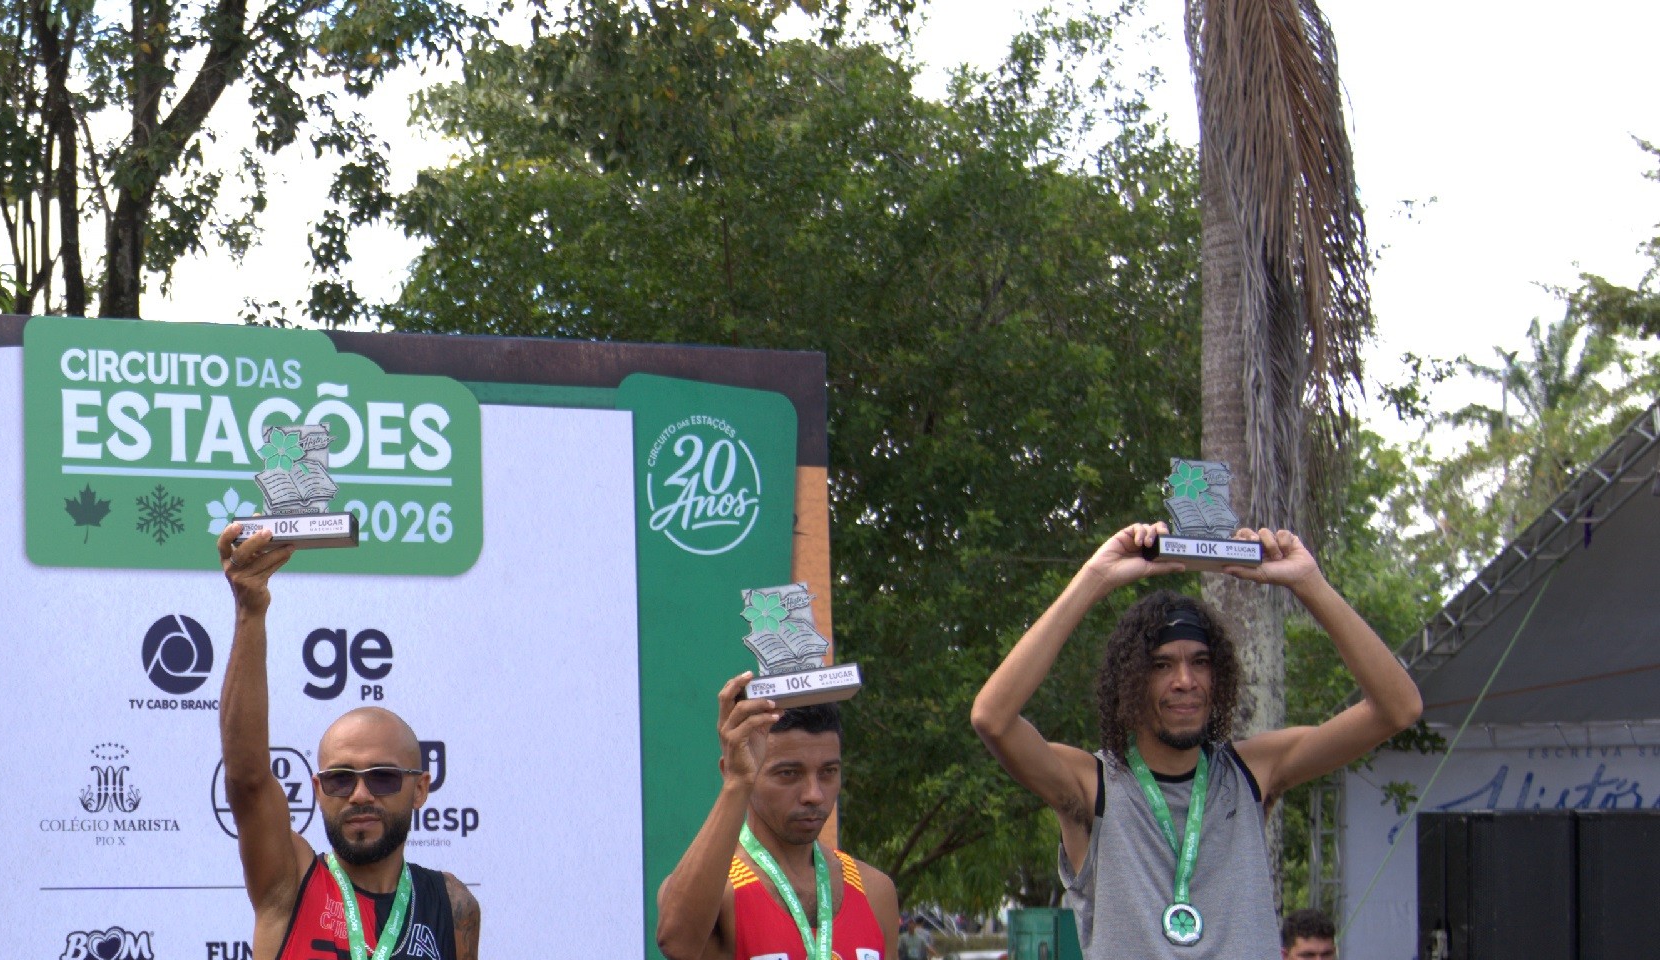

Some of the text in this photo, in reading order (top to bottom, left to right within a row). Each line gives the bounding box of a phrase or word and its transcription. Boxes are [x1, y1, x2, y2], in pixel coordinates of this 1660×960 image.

[61, 348, 302, 389] CIRCUITO DAS
[648, 425, 677, 467] CIRCUITO
[690, 415, 736, 438] ESTAÇÕES
[664, 435, 737, 495] 20
[649, 472, 760, 531] Anos
[274, 520, 299, 534] 10K
[319, 518, 343, 527] LUGAR
[344, 498, 453, 545] 2026
[1234, 546, 1256, 554] LUGAR
[301, 628, 393, 701] ge
[785, 675, 812, 690] 10K
[829, 670, 853, 679] LUGAR
[129, 699, 221, 711] TV CABO BRANC
[361, 685, 384, 701] PB
[40, 816, 180, 832] COLÉGIO MARISTA
[414, 807, 479, 838] iesp
[95, 836, 126, 846] PIO X
